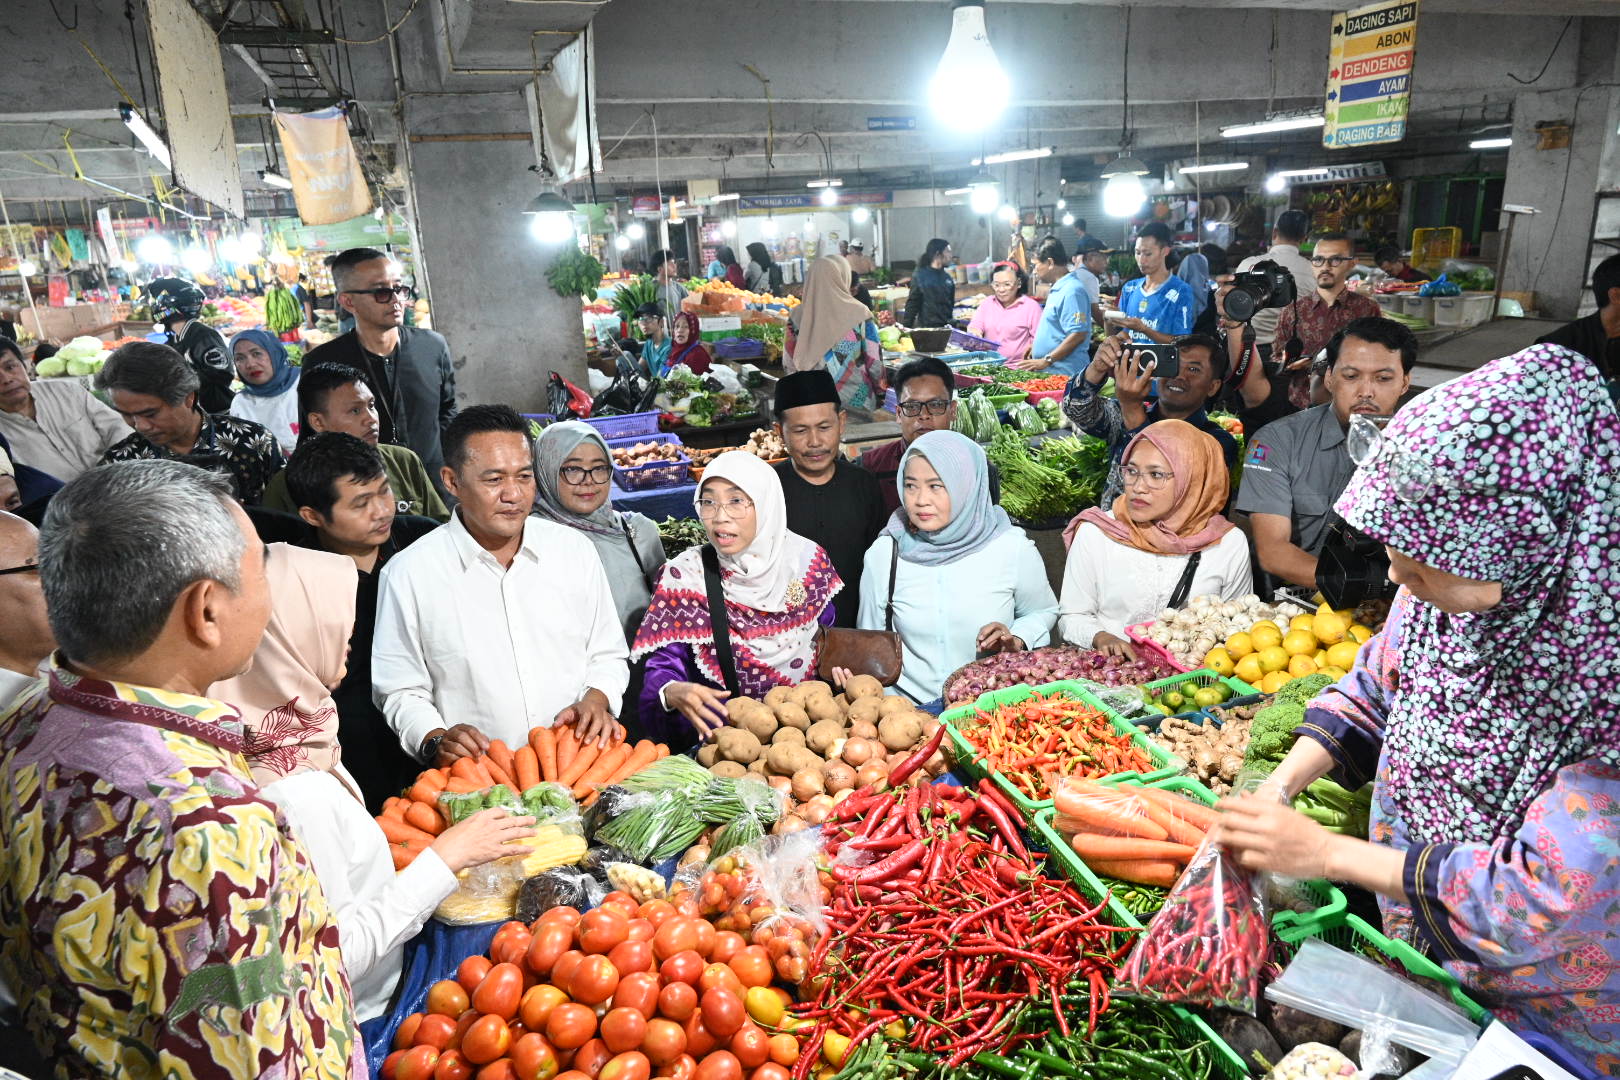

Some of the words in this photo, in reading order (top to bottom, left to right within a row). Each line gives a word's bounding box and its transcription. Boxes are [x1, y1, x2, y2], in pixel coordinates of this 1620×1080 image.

[1347, 12, 1386, 33] DAGING
[1388, 6, 1412, 23] SAPI
[1376, 30, 1411, 48] ABON
[1344, 54, 1408, 77] DENDENG
[1378, 77, 1407, 94] AYAM
[1376, 101, 1404, 116] IKAN
[1338, 127, 1375, 143] DAGING
[1376, 123, 1401, 138] BABI
[1236, 349, 1251, 376] Canon
